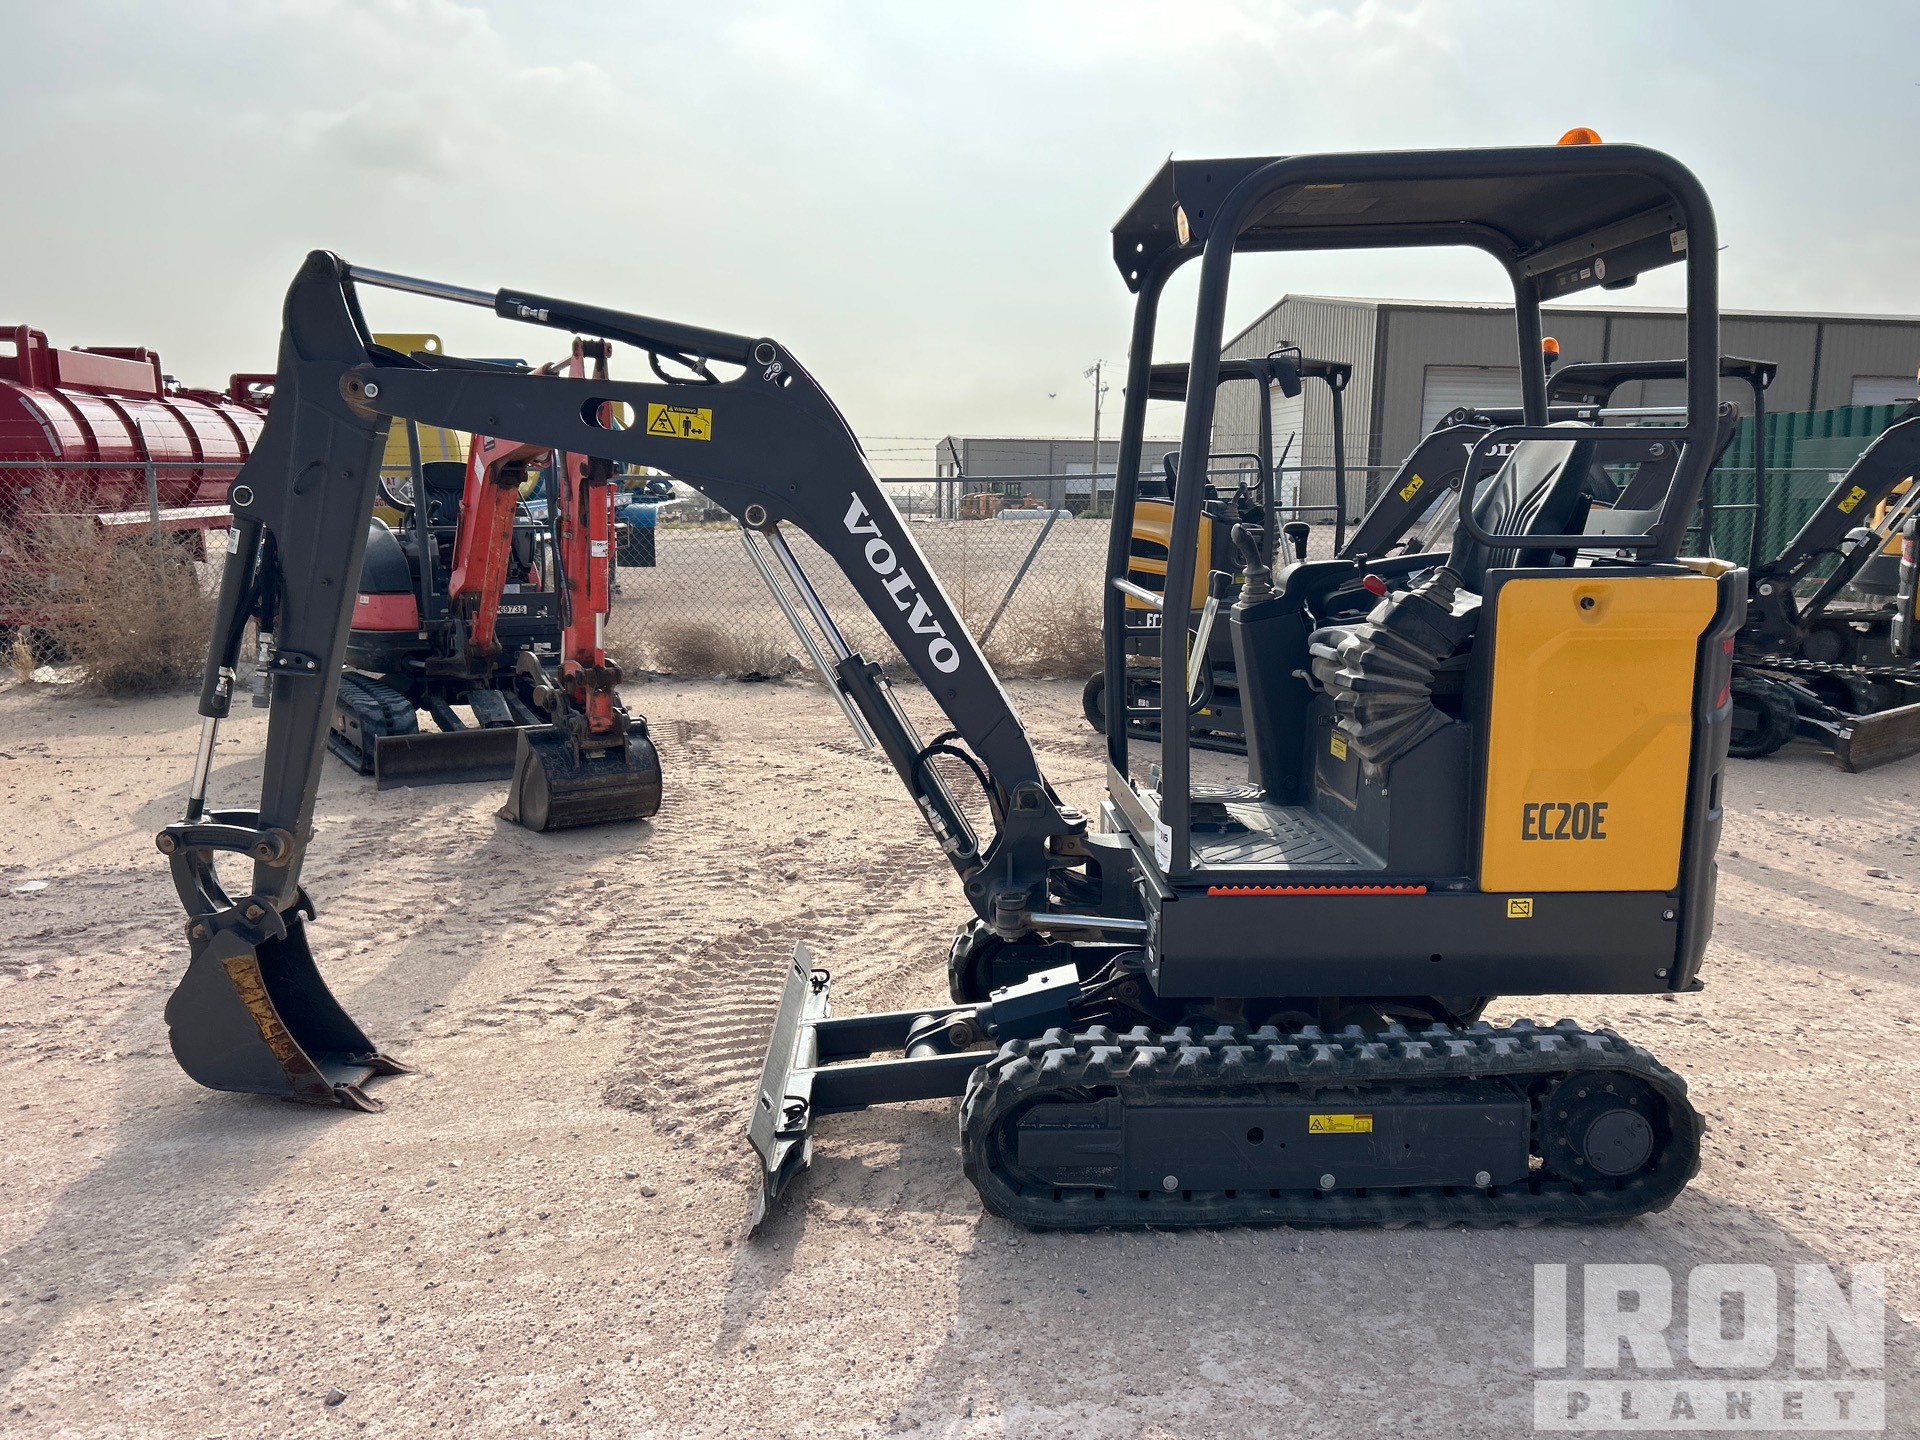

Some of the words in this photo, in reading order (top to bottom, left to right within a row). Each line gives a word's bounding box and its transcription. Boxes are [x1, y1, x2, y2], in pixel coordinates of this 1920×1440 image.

[1462, 443, 1518, 456] VOL
[843, 491, 960, 673] VOLVO
[1522, 802, 1609, 840] EC20E
